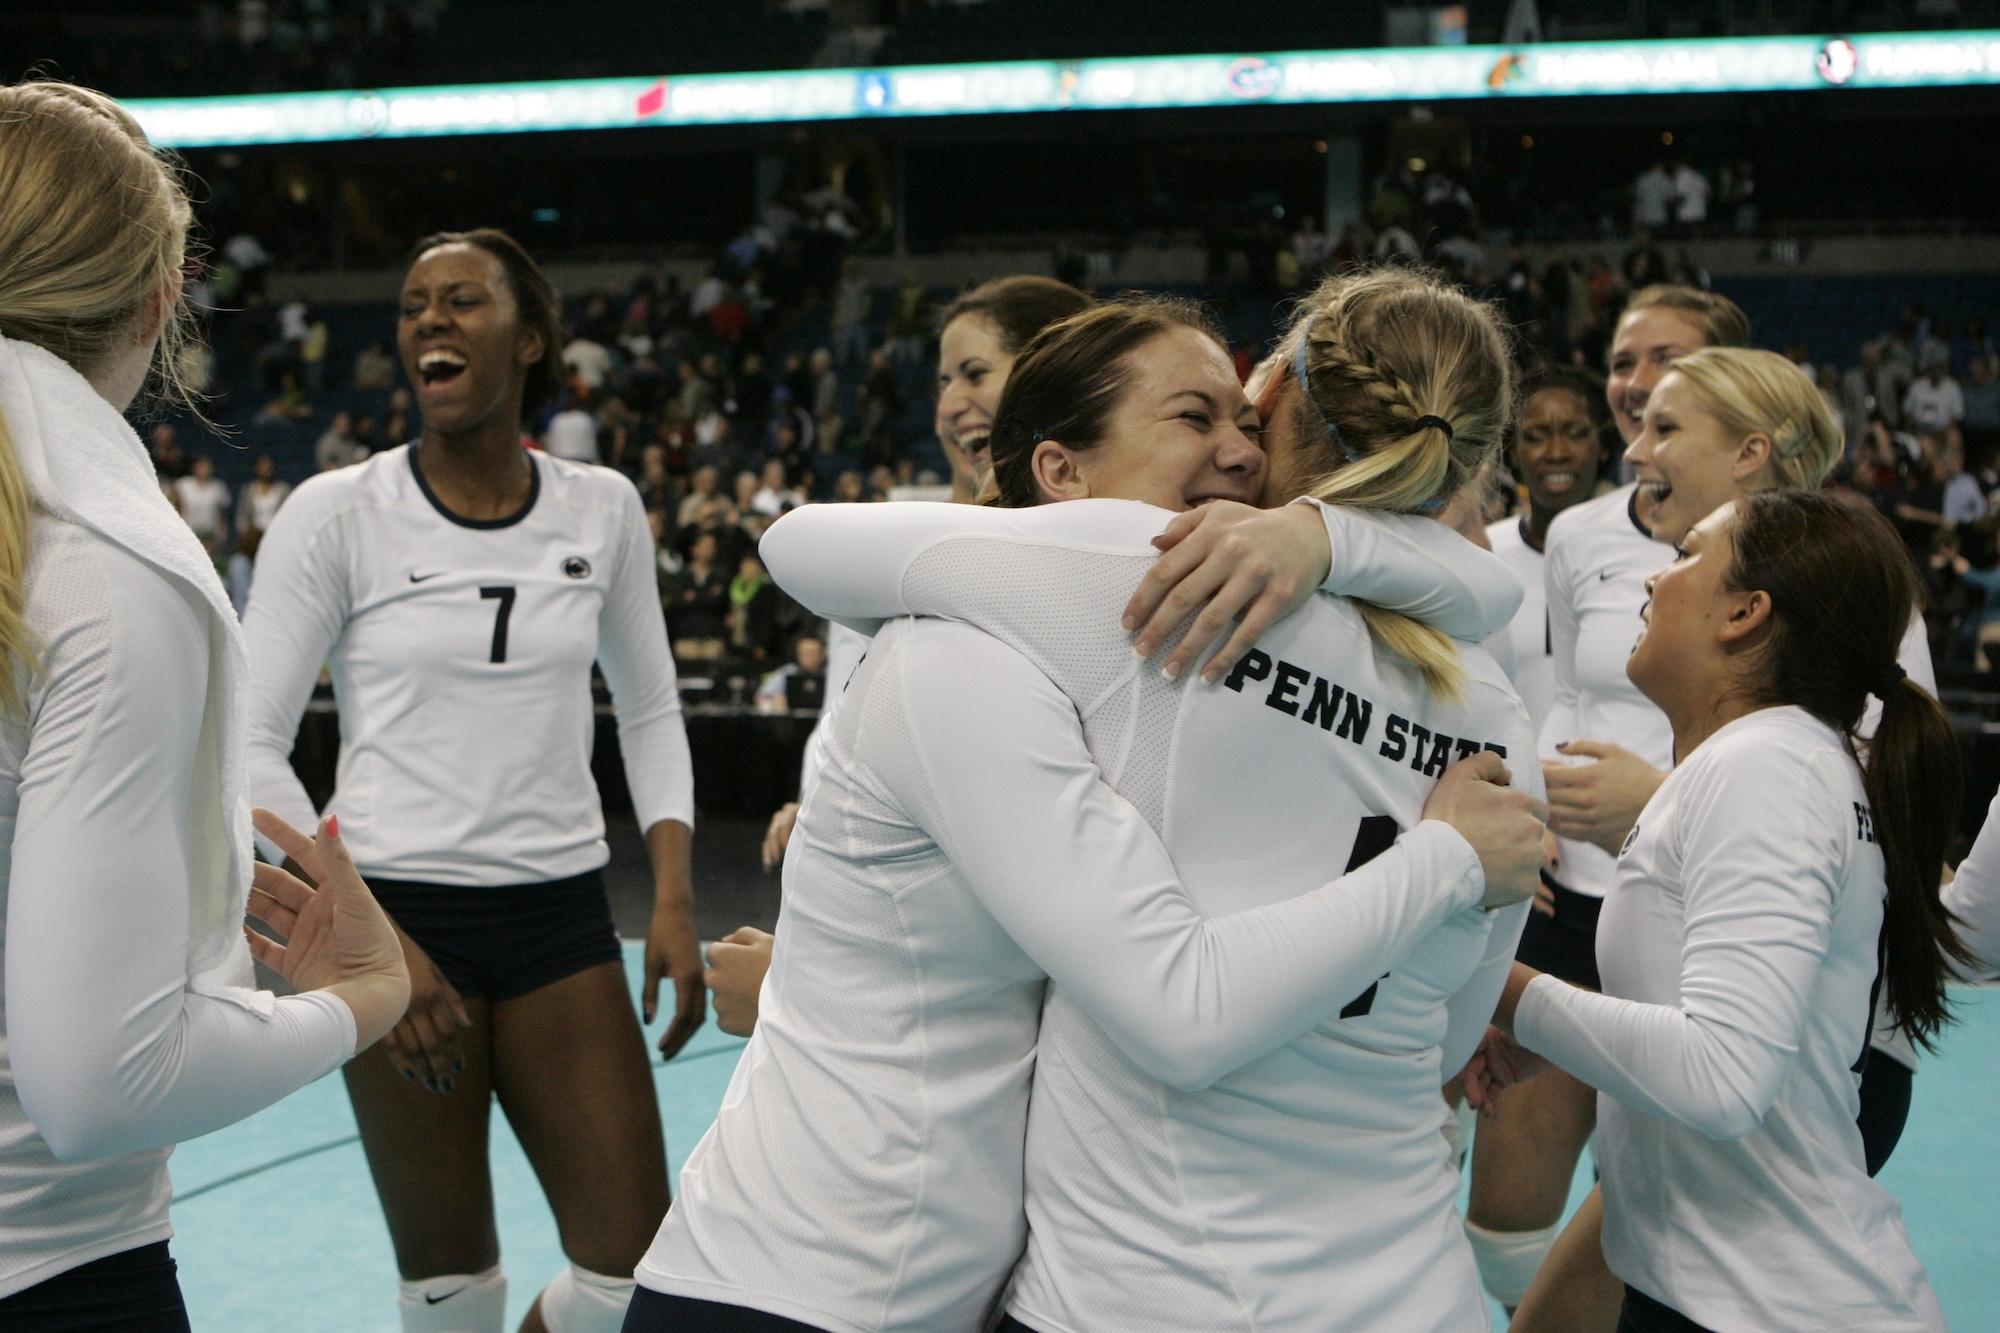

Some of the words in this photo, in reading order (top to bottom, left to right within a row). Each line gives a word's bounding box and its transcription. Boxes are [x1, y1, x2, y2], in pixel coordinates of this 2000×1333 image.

[480, 586, 516, 663] 7
[1224, 648, 1373, 745] PENN
[1379, 713, 1508, 782] STA
